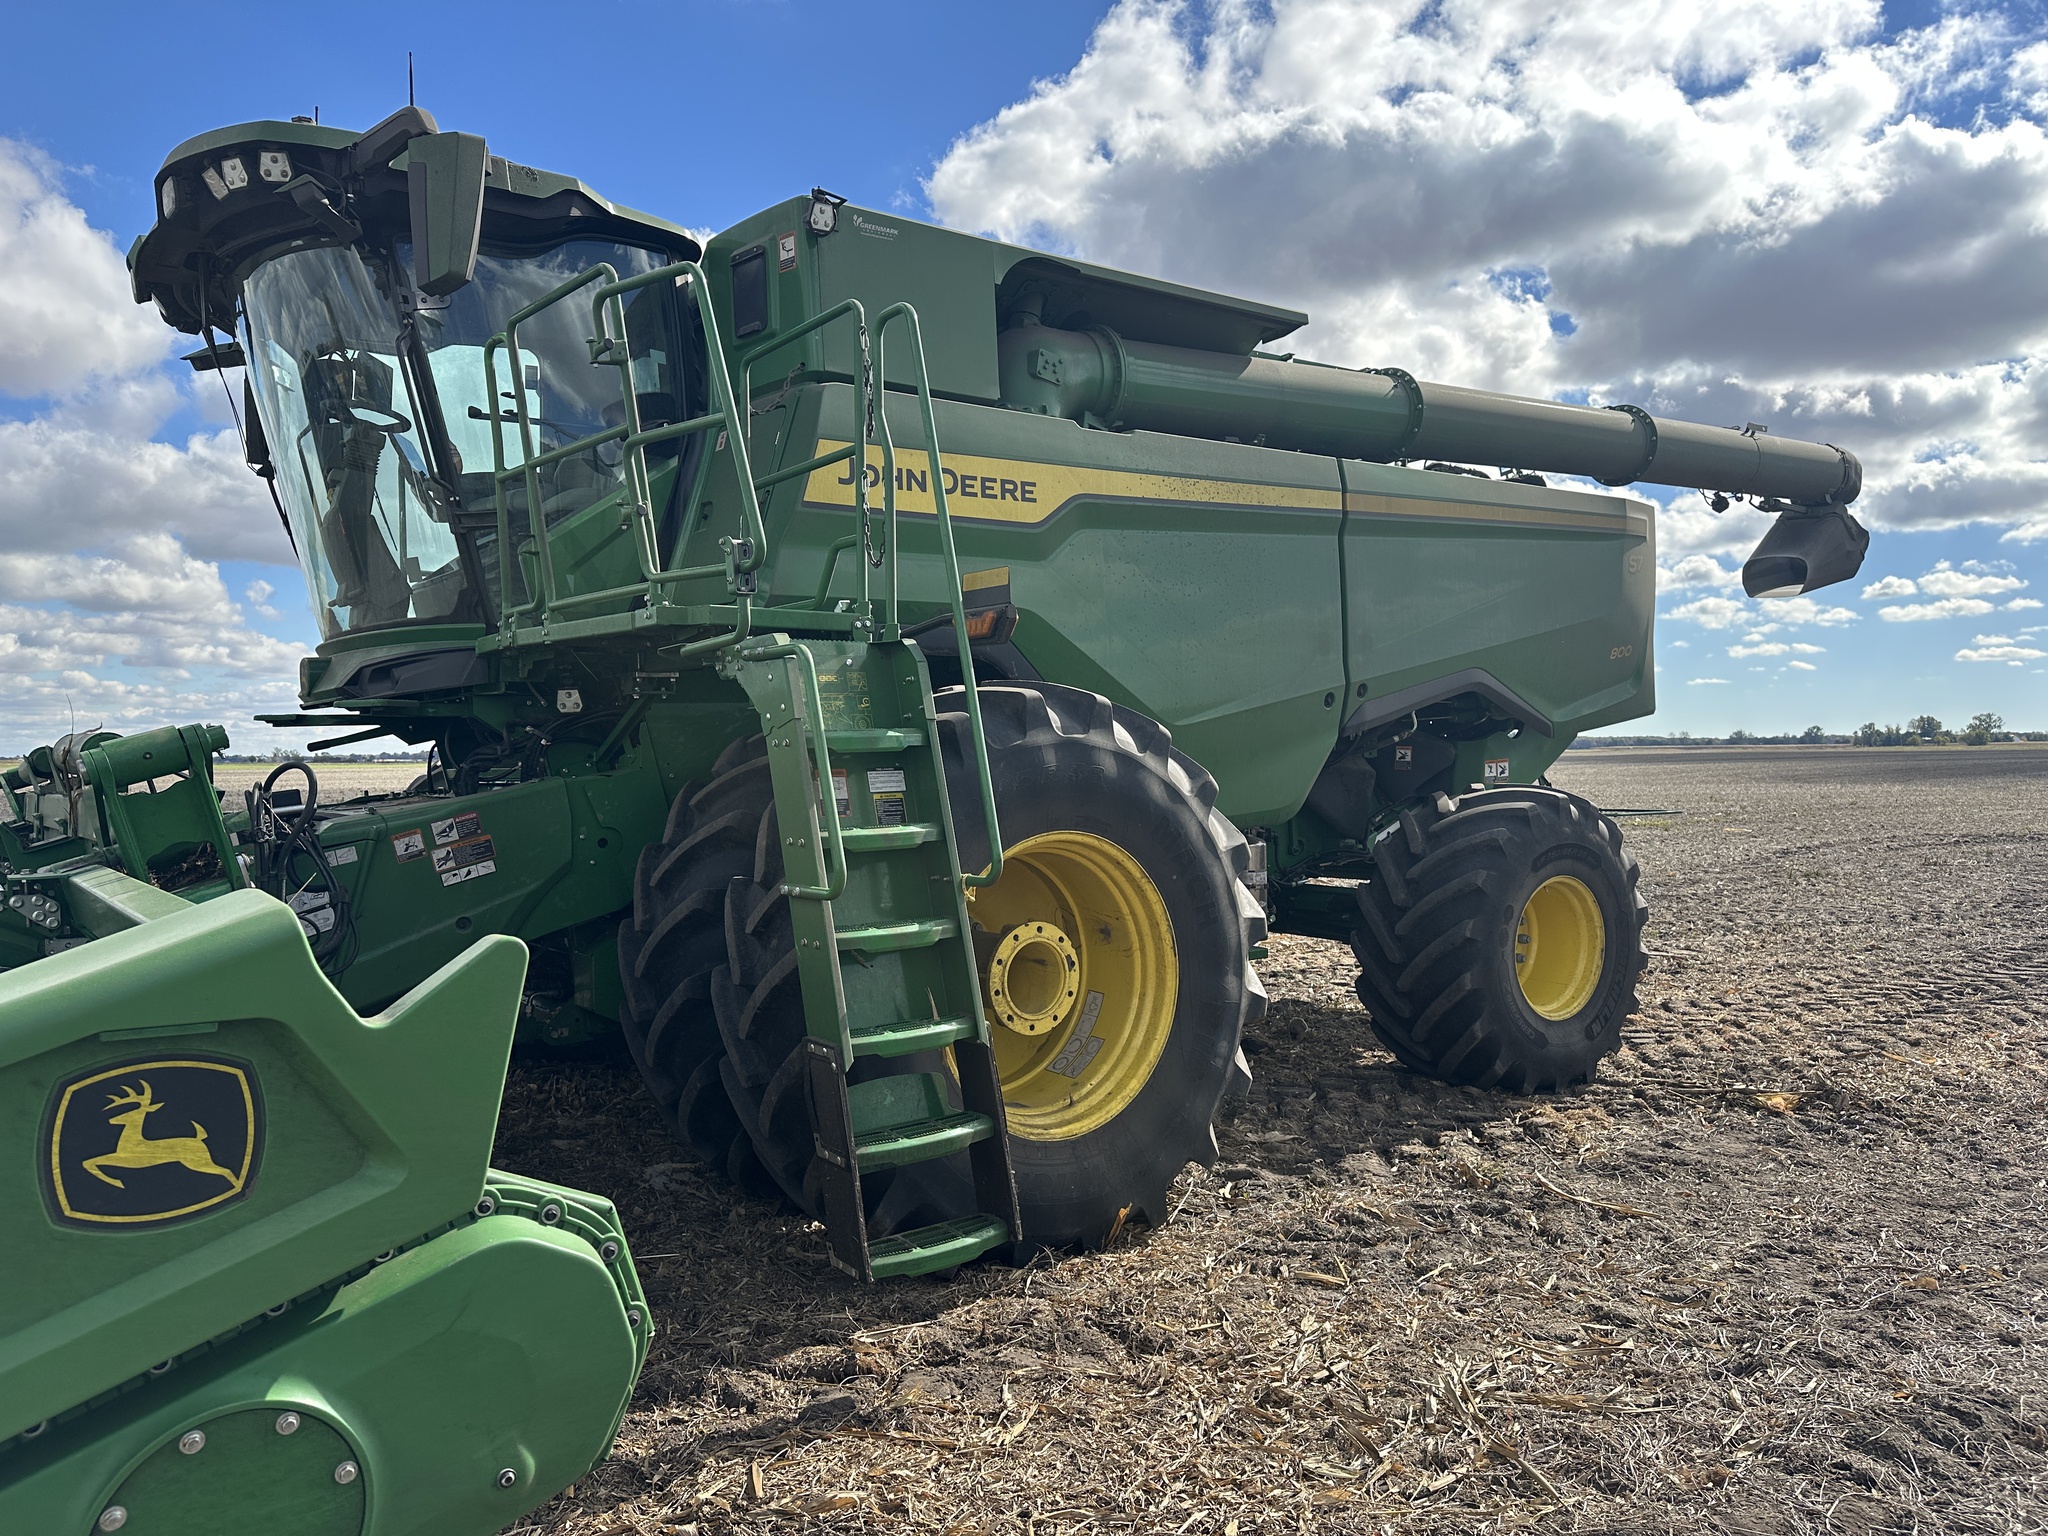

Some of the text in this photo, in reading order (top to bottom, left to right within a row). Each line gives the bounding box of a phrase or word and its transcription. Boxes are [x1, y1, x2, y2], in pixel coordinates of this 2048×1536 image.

[860, 222, 899, 235] GREENMARK
[838, 456, 1037, 503] JOHN DEERE
[1628, 555, 1644, 574] S7
[1610, 645, 1633, 660] 800
